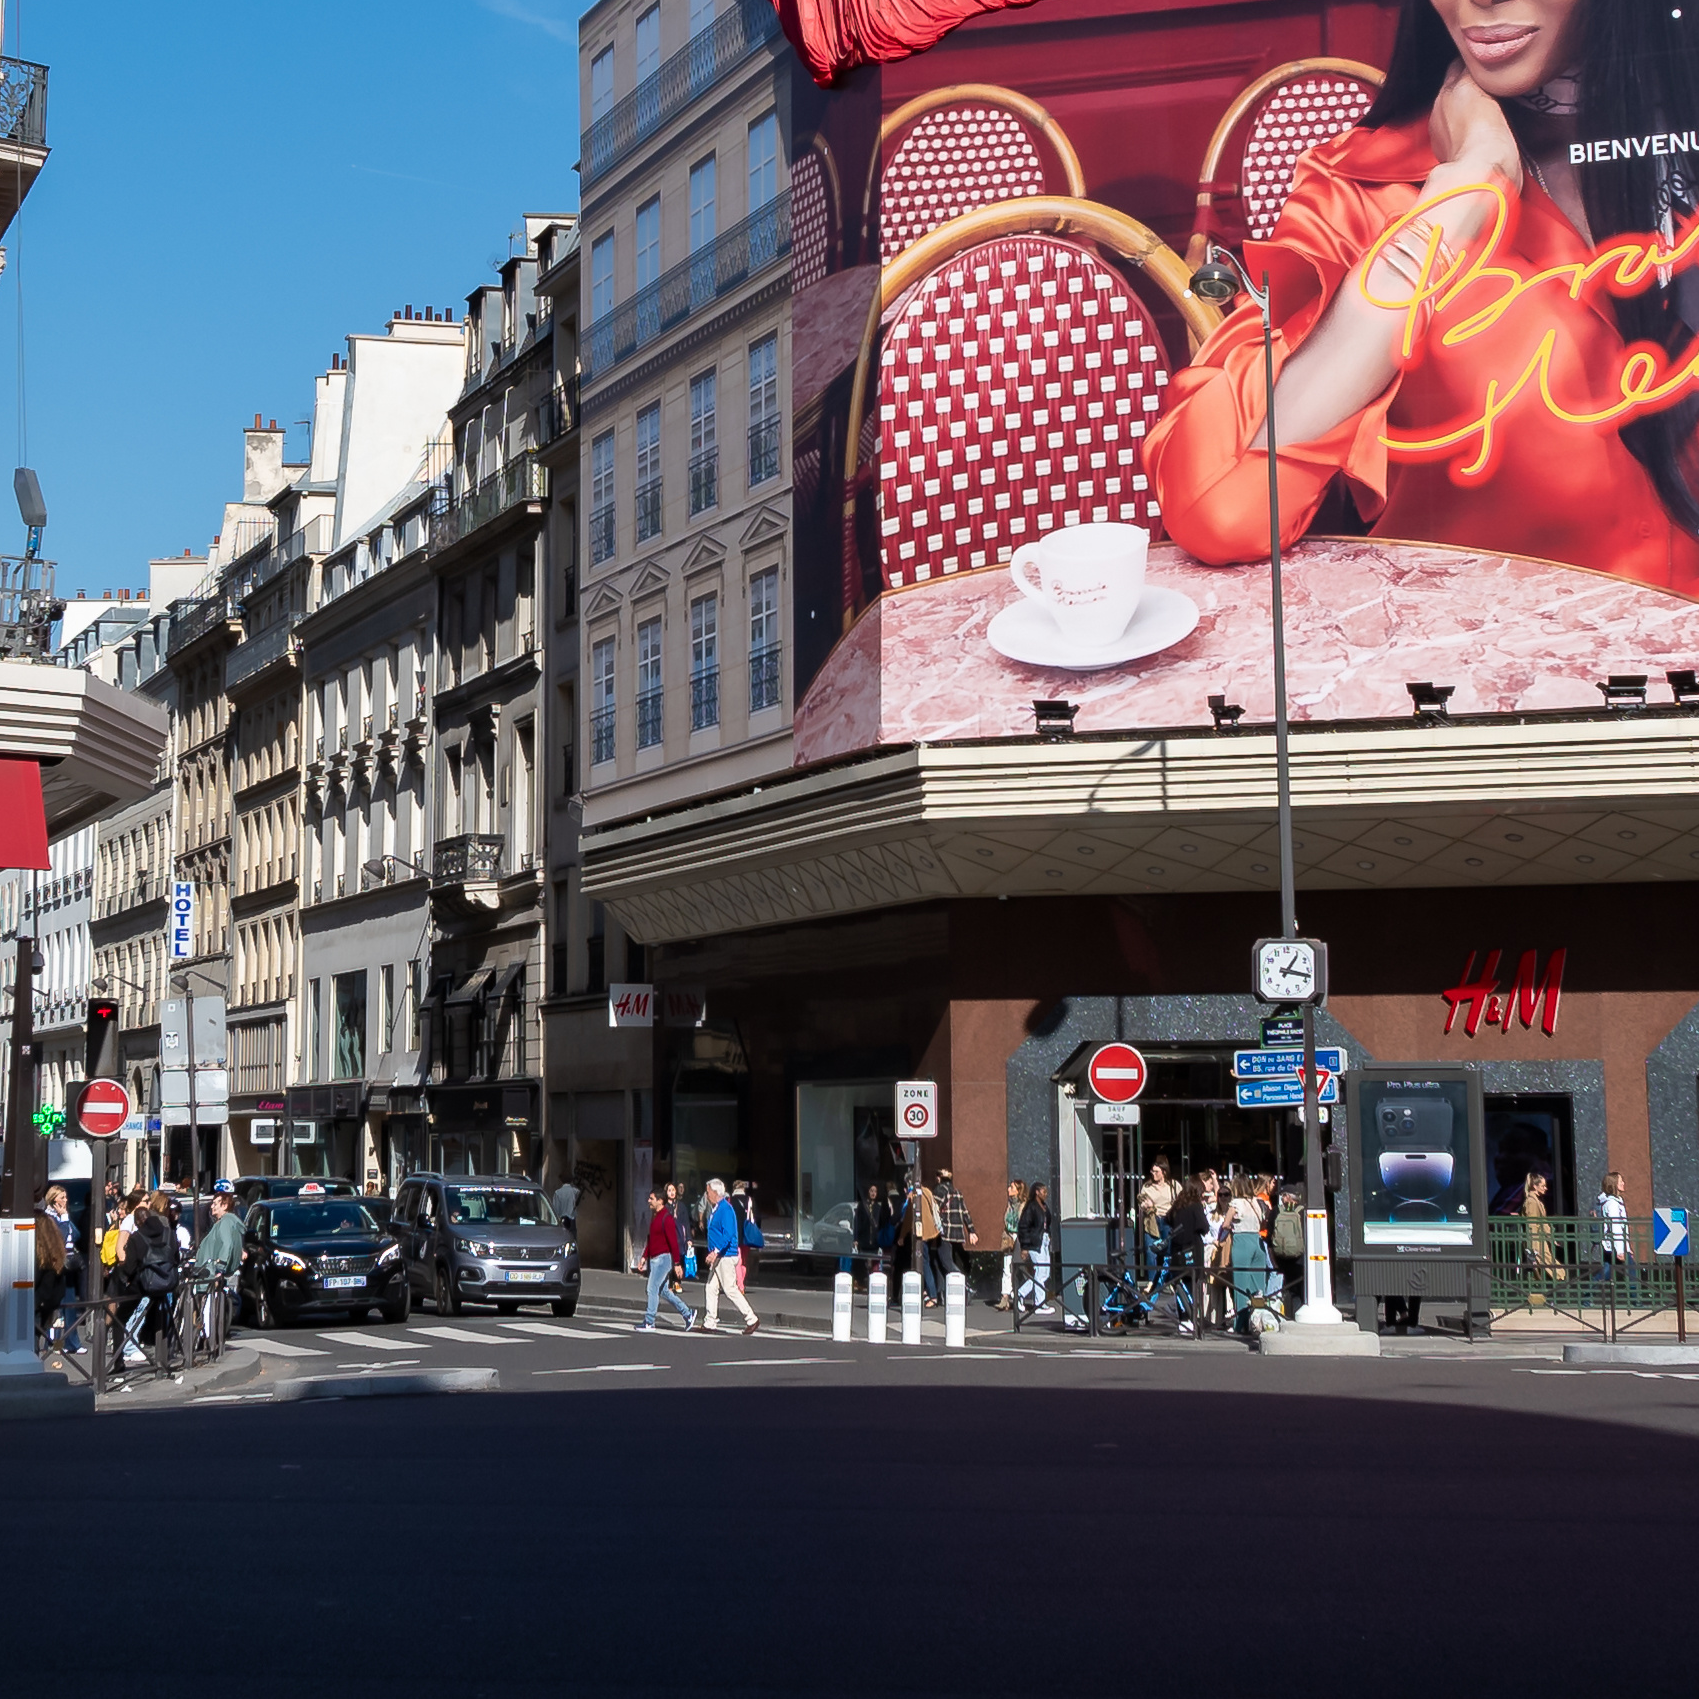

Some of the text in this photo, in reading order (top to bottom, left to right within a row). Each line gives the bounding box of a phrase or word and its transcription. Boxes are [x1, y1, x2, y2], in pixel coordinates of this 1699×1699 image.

[174, 883, 191, 957] HOTEL
[615, 993, 649, 1017] H&M
[1441, 947, 1566, 1039] H&M
[904, 1089, 928, 1098] ZONE
[909, 1110, 924, 1121] 30
